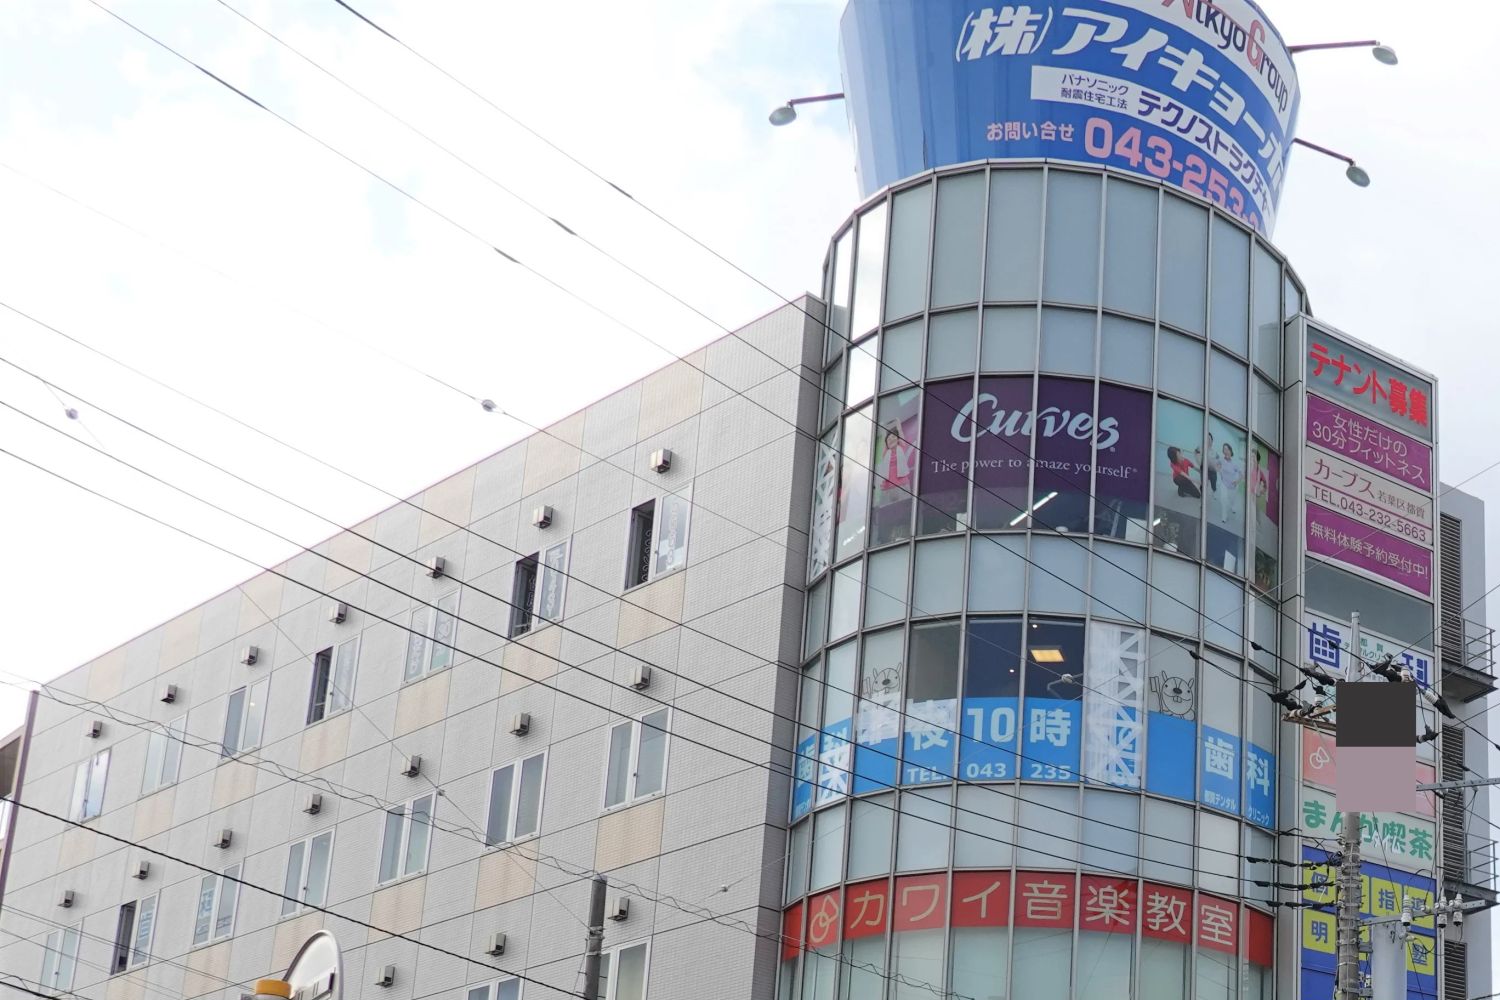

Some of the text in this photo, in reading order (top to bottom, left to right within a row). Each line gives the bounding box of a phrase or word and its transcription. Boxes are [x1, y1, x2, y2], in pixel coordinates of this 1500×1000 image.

[1060, 88, 1128, 110] 耐震住宅工法
[1061, 74, 1129, 95] パナソニック
[986, 121, 1075, 142] お問い合せ
[1309, 342, 1429, 428] テナント募集
[950, 392, 1120, 451] Curves
[1332, 413, 1408, 457] 女性だけの
[931, 459, 956, 475] The
[961, 460, 999, 475] power
[1008, 459, 1022, 469] to
[1027, 460, 1070, 471] amaze
[1312, 421, 1425, 484] 30分フィットネス
[1314, 458, 1376, 499] カーブス
[1313, 485, 1427, 542] TEL.043-232-5663
[966, 762, 1007, 778] 043
[850, 879, 1234, 946] カワイ音楽教室
